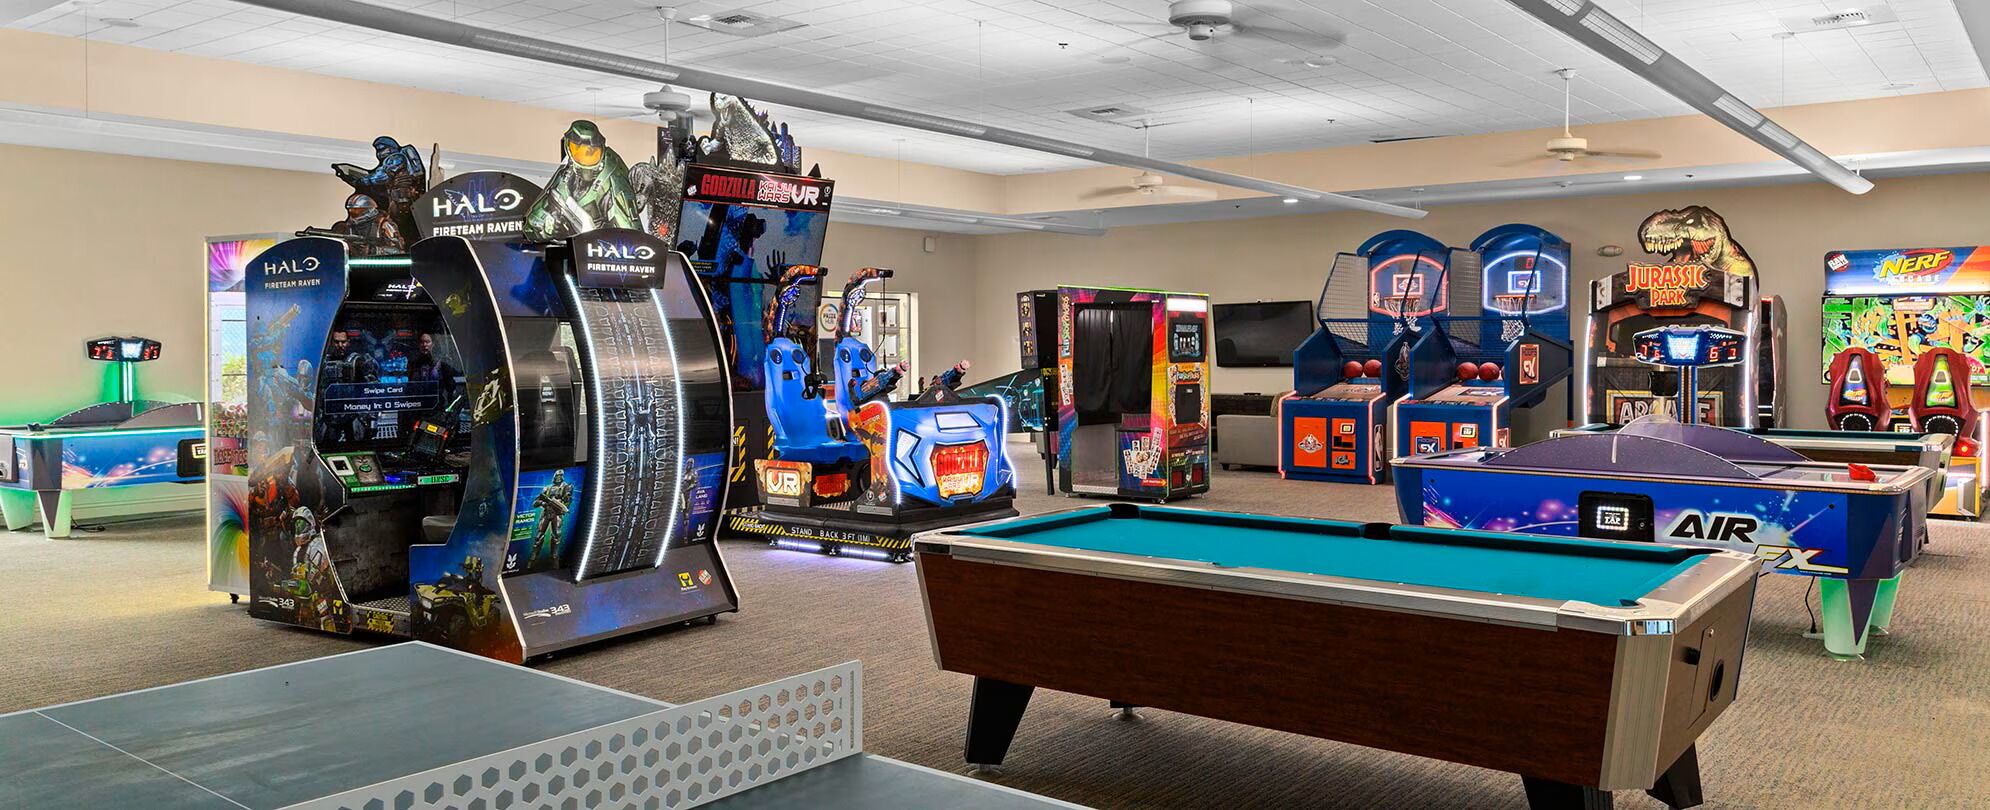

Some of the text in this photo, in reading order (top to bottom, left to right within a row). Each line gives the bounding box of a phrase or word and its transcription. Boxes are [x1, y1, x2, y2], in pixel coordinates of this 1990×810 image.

[701, 174, 756, 199] GODZILLA
[759, 180, 792, 192] KAIJU
[790, 184, 820, 206] VR
[433, 189, 524, 217] HALO
[757, 190, 790, 203] WARS
[433, 221, 522, 236] FIRETEAM RAVEN
[587, 243, 656, 260] HALO
[264, 256, 321, 276] HALO
[587, 263, 655, 274] FIRETEAM RAVEN
[1880, 250, 1951, 279] NERF
[264, 278, 321, 290] FIRETEAM RAVEN
[1626, 264, 1708, 292] JURASSIC
[1650, 288, 1687, 307] PARK
[344, 403, 371, 411] Money
[1620, 399, 1710, 425] ARAE
[936, 449, 984, 477] GODZILLA
[768, 471, 797, 493] VR
[791, 526, 813, 536] STAND
[819, 530, 839, 539] BACK
[1670, 514, 1753, 543] AIR
[278, 598, 295, 607] 343
[550, 604, 571, 614] 343
